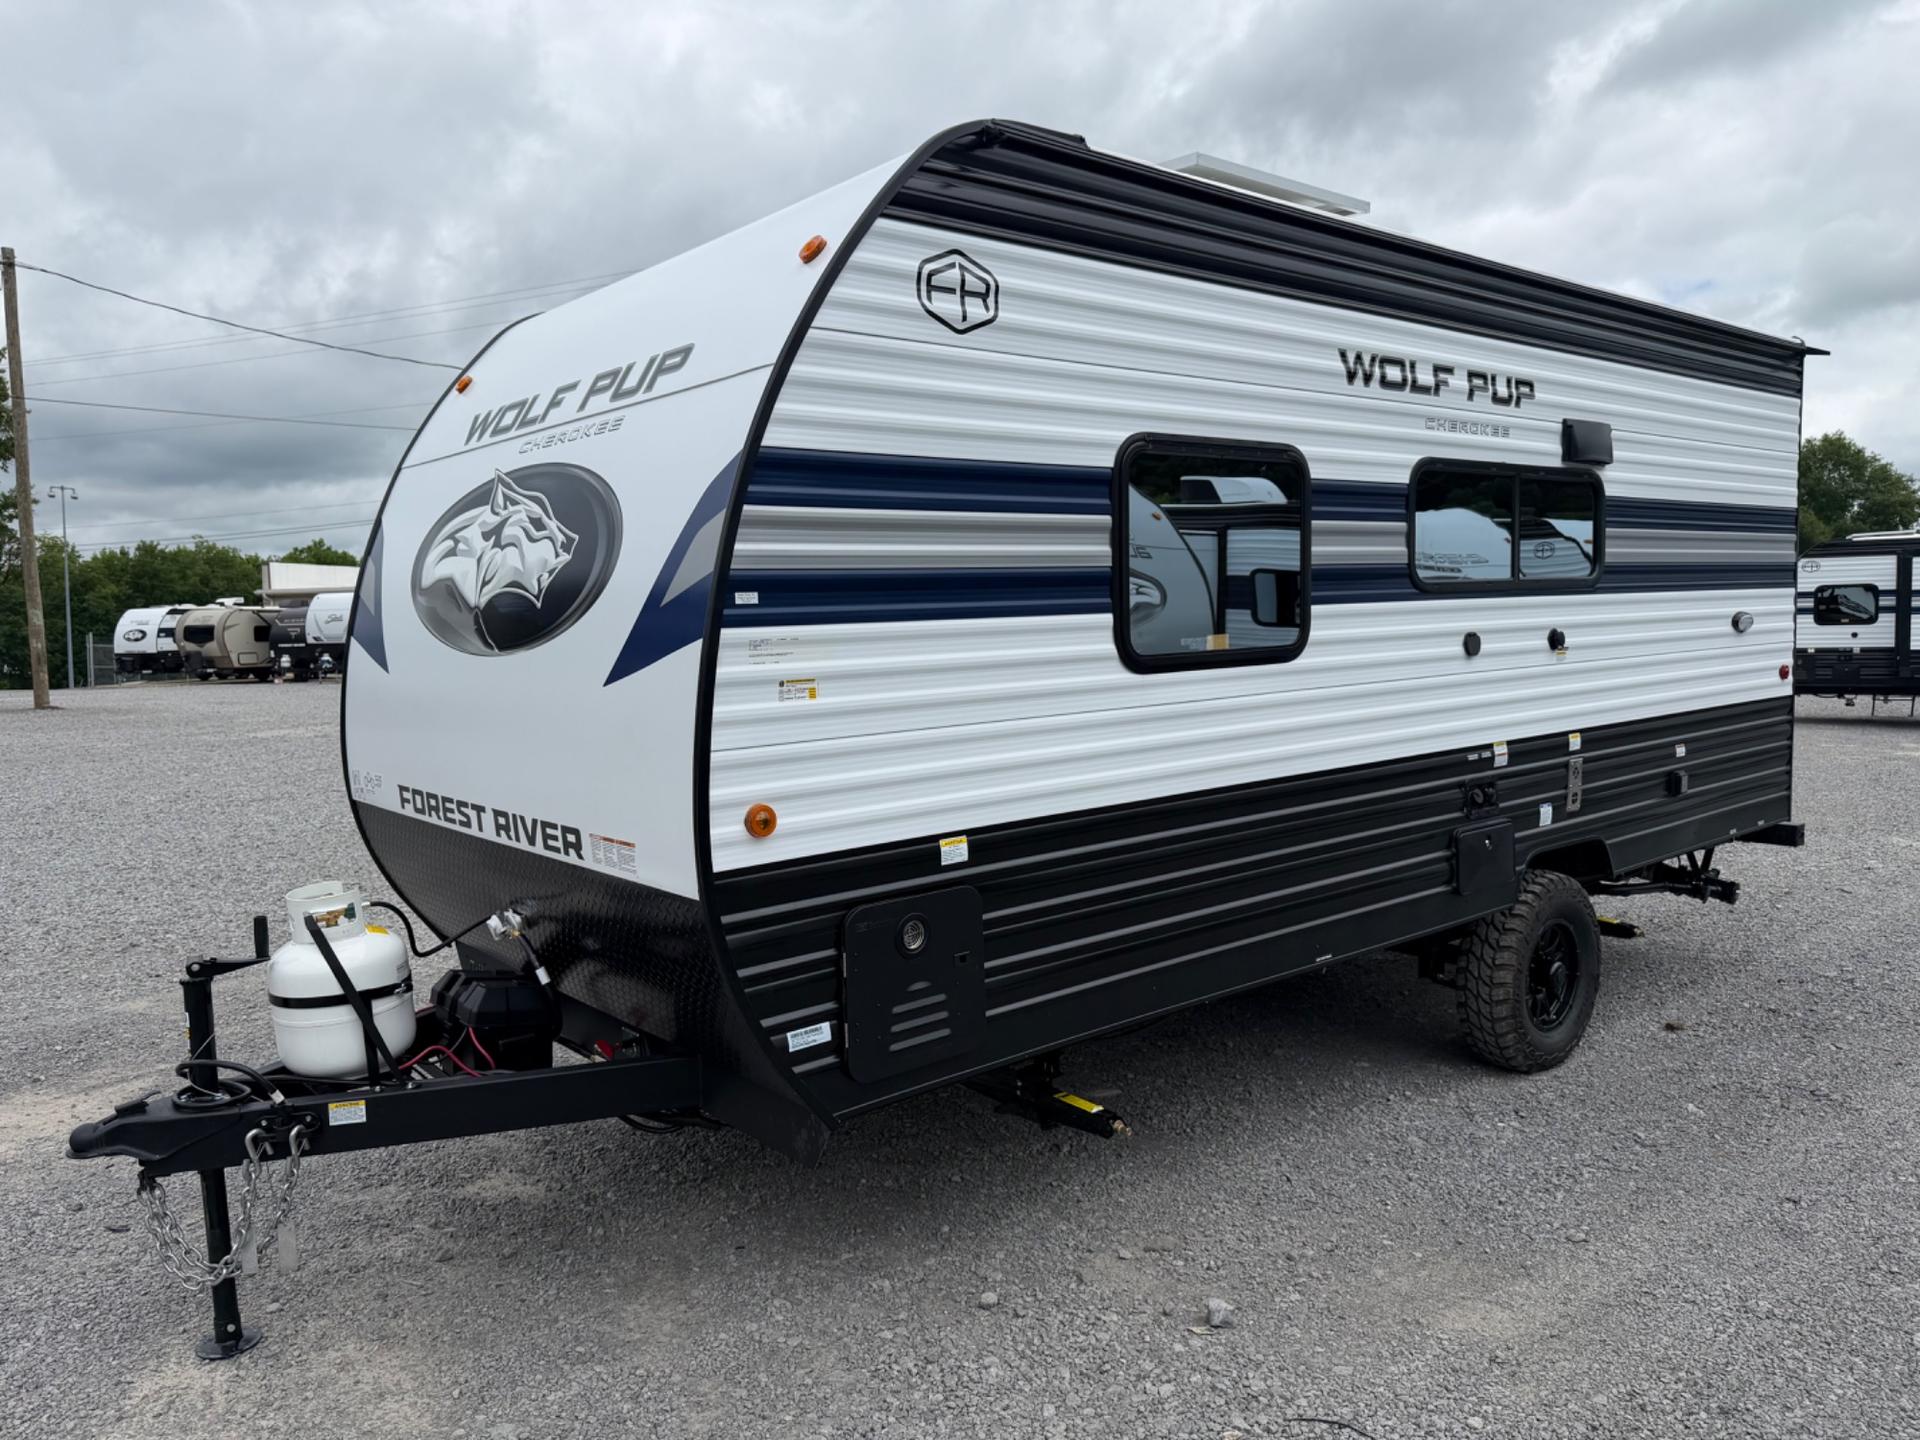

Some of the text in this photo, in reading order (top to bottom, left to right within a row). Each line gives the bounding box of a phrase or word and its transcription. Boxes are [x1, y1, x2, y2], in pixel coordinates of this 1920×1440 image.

[463, 342, 696, 446] WOLF PUP
[1337, 348, 1536, 409] WOLF PUP
[517, 414, 626, 455] CHEROKEE
[1424, 417, 1511, 438] CHEROKEE
[397, 784, 486, 833] FOREST
[491, 808, 585, 861] RIVER
